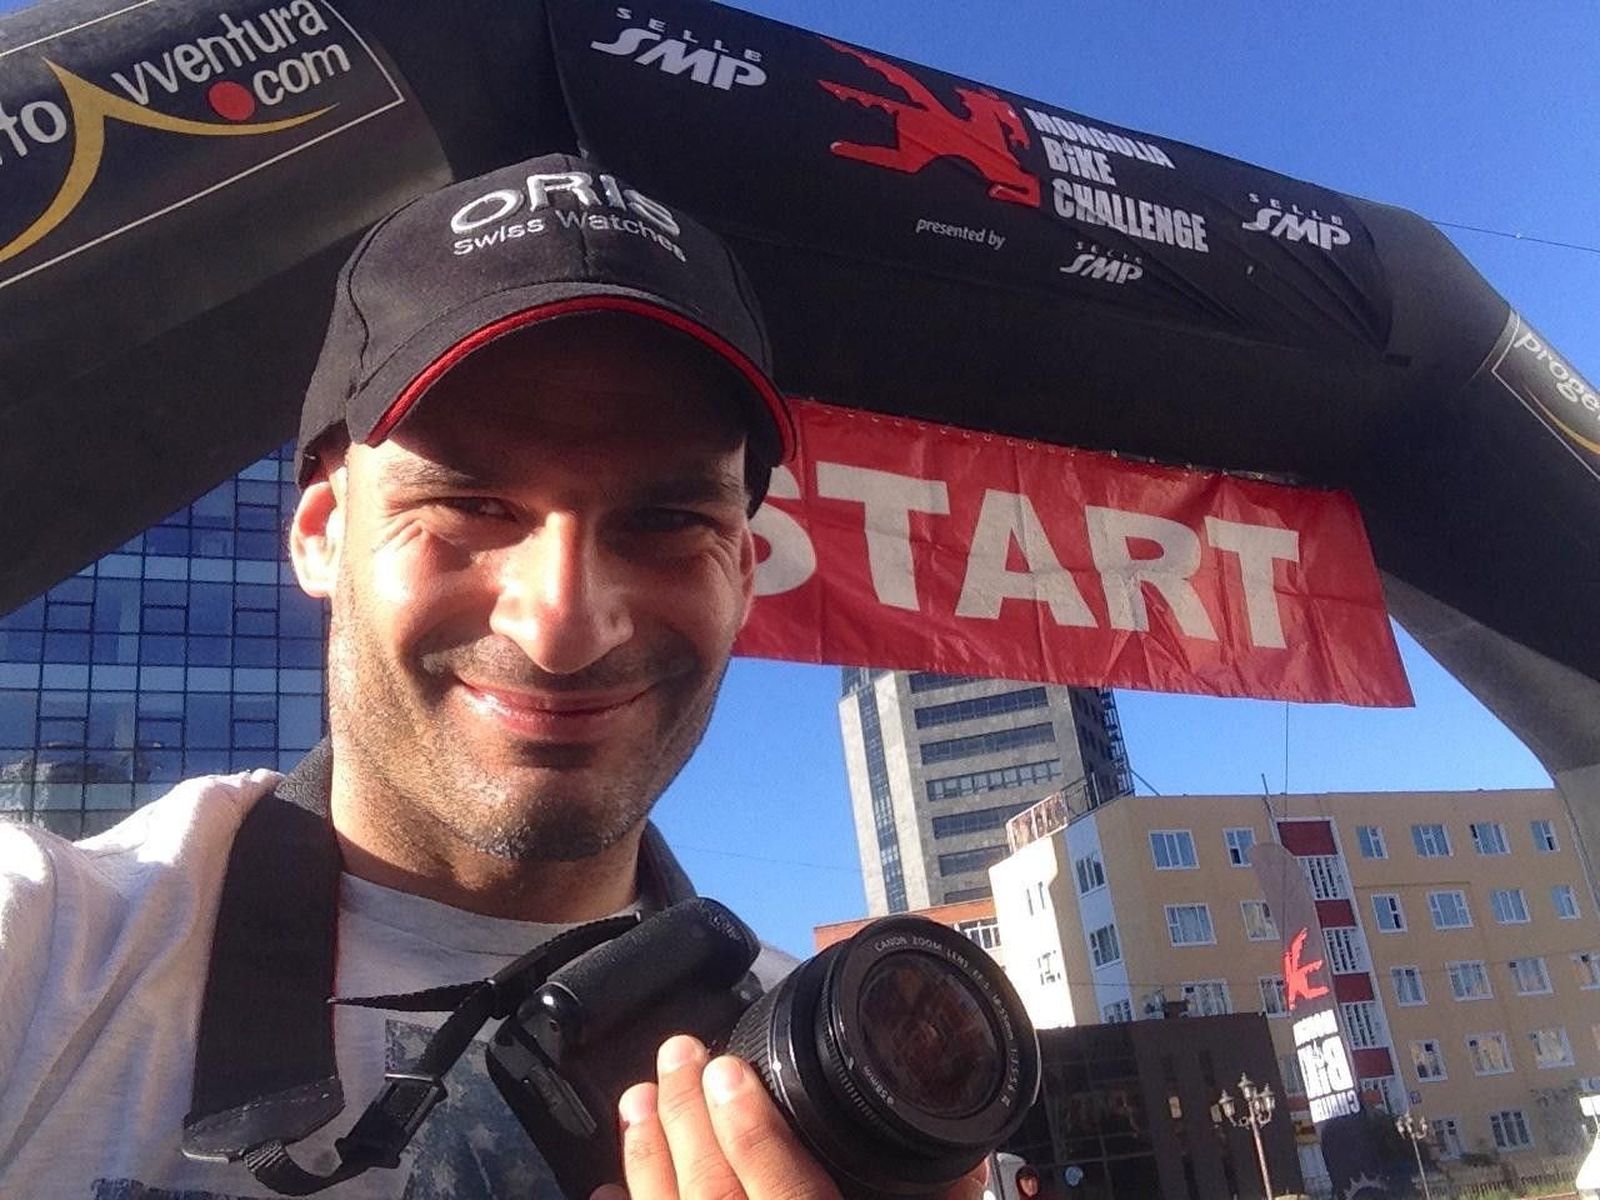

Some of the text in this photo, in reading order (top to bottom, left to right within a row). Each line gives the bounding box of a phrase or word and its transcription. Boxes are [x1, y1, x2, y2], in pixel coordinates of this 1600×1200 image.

[591, 27, 767, 91] SMP
[616, 6, 763, 63] SELLE
[1024, 106, 1176, 170] MONGOLIA
[450, 171, 681, 235] ORIS
[1051, 177, 1210, 253] CHALLENGE
[1242, 206, 1350, 250] SMP
[453, 217, 545, 256] Swiss
[915, 218, 1006, 251] presented by
[1059, 253, 1144, 285] SMP
[1514, 332, 1600, 418] proge
